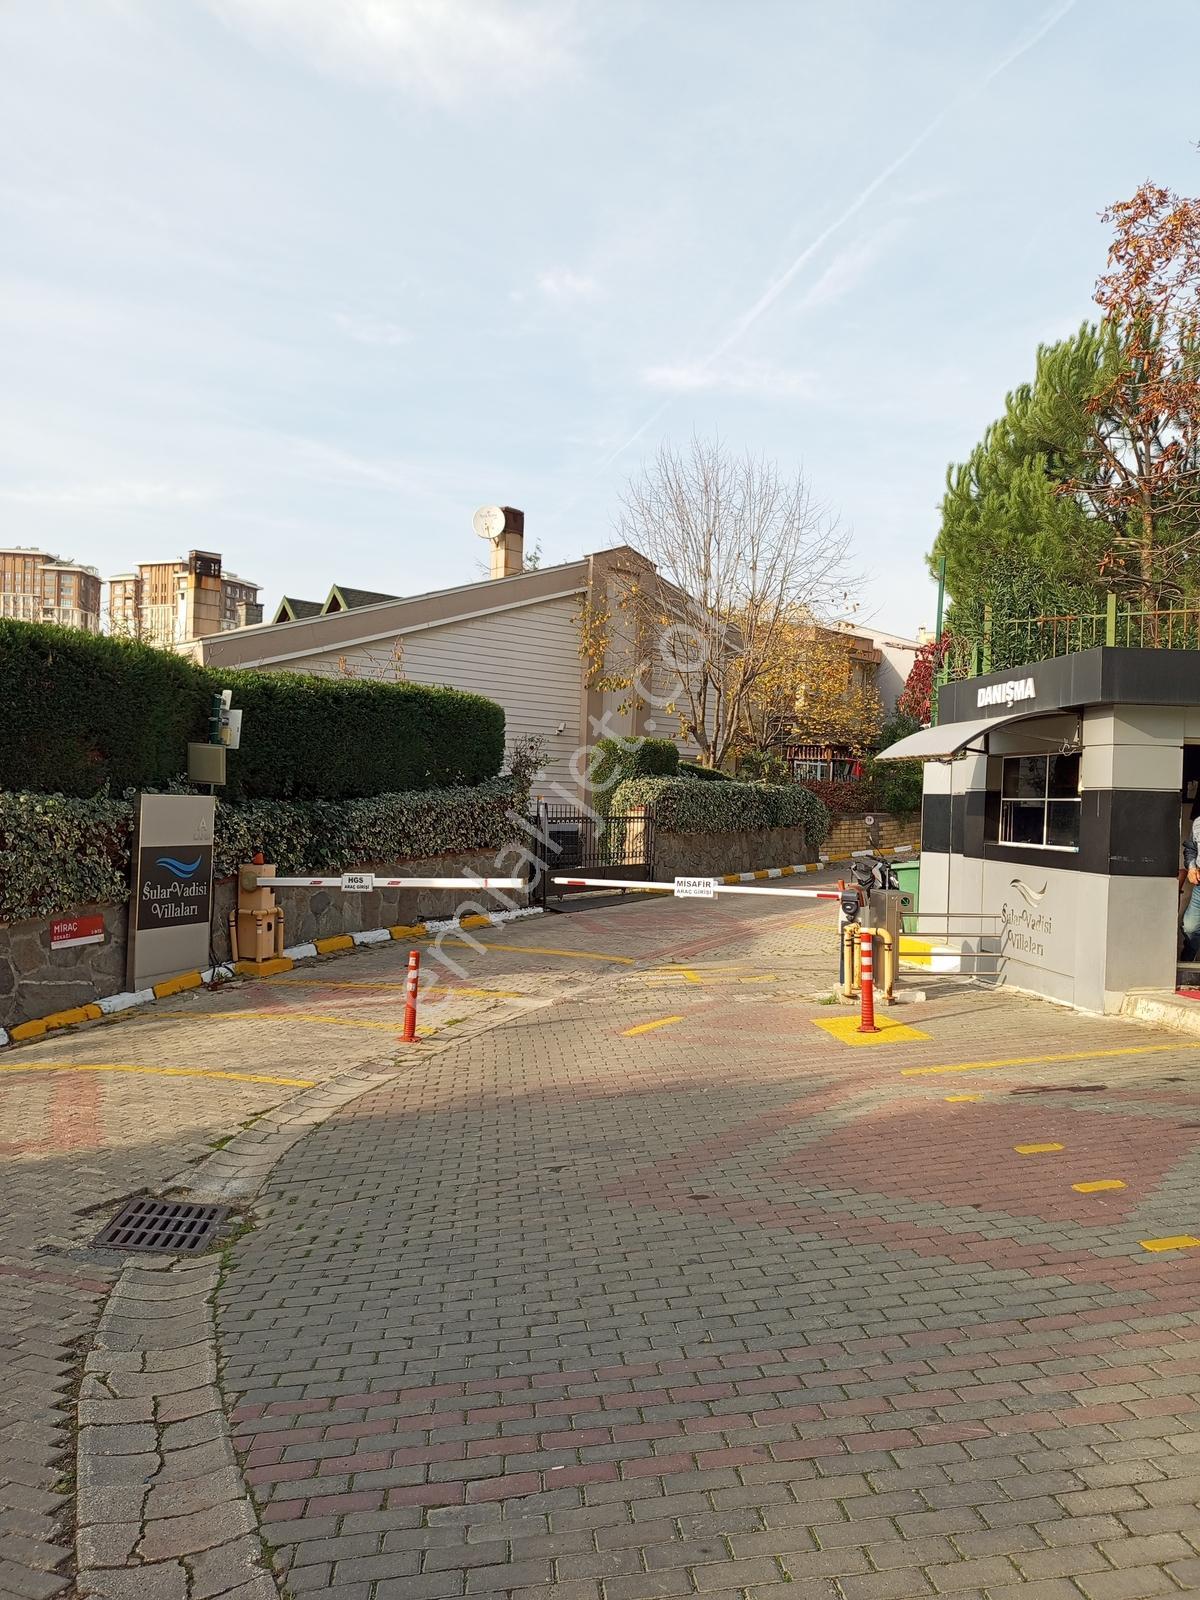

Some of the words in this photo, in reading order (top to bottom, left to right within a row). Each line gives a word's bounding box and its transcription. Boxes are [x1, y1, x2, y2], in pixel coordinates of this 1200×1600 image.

[977, 677, 1036, 708] DANIŞMA
[142, 881, 173, 901] Sular
[171, 881, 208, 898] Vadisi
[151, 902, 199, 919] Villaları
[54, 922, 78, 933] MİRAÇ
